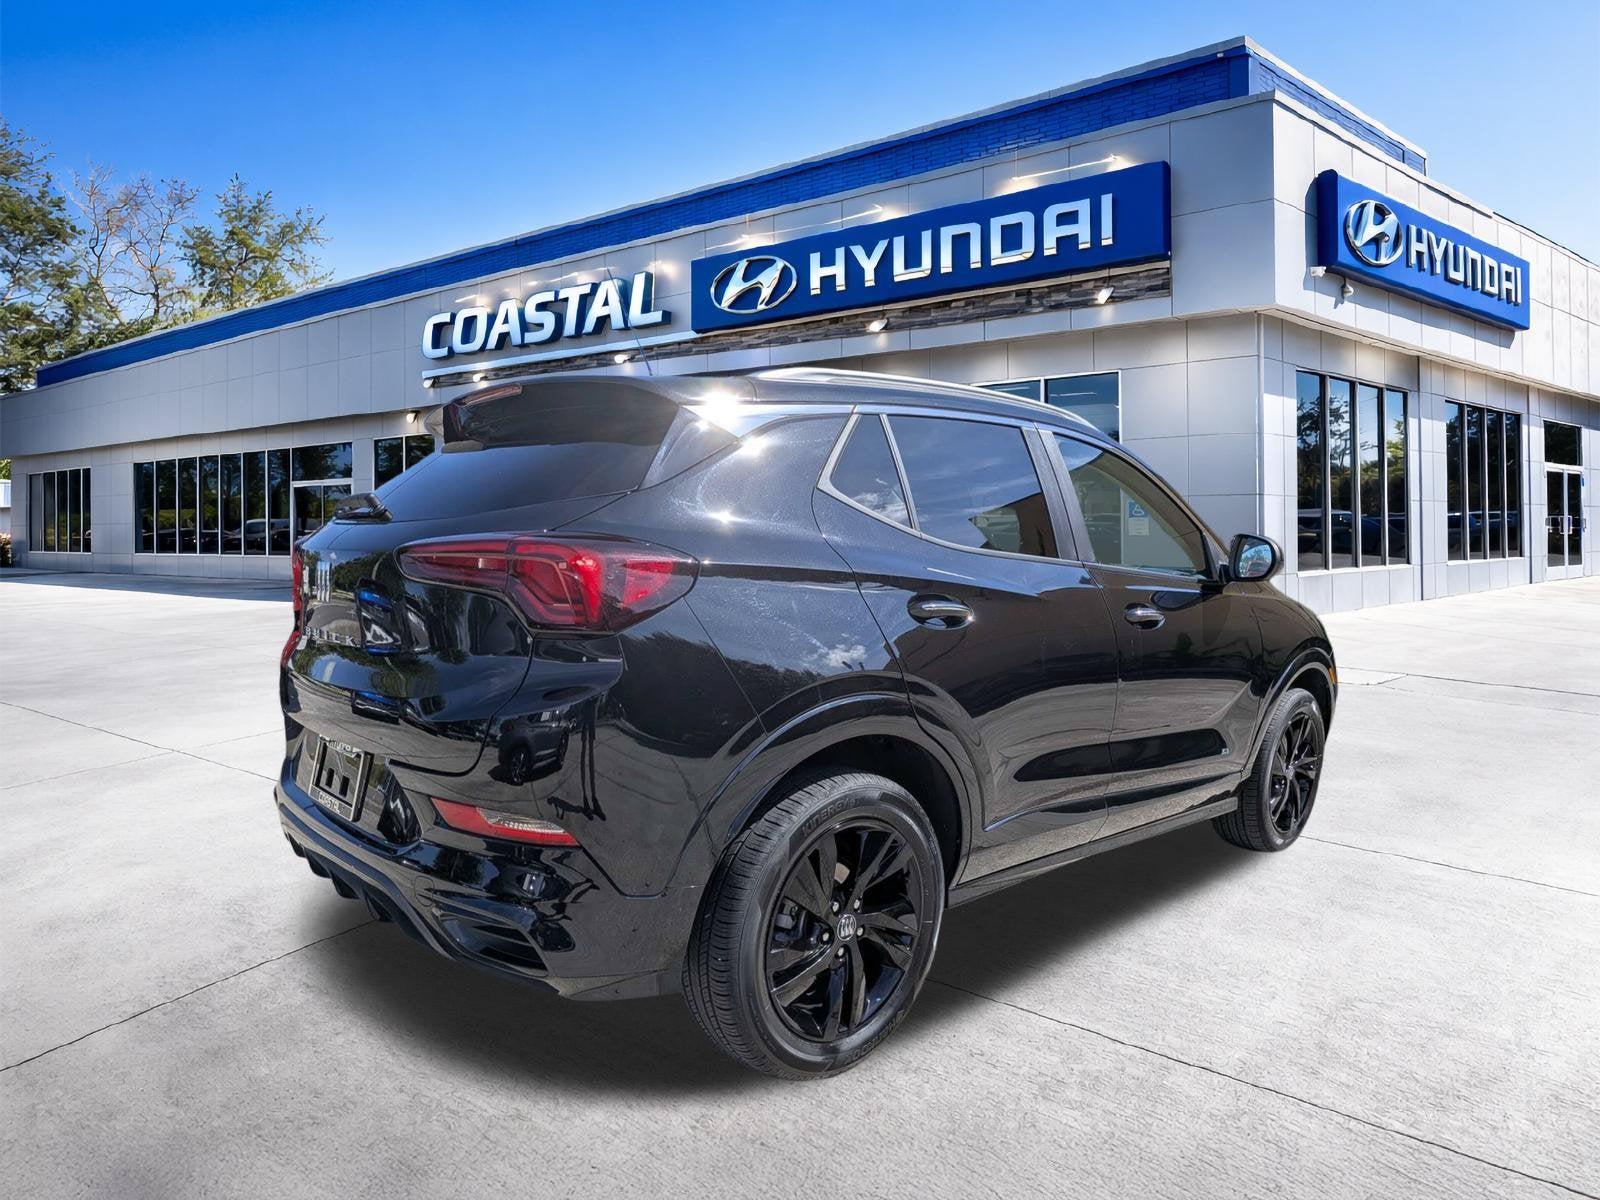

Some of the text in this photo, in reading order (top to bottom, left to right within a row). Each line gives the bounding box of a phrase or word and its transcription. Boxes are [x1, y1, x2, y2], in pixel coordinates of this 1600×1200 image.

[422, 193, 1114, 359] COASTAL HYUNDAI
[1406, 224, 1522, 306] HYUNDAI
